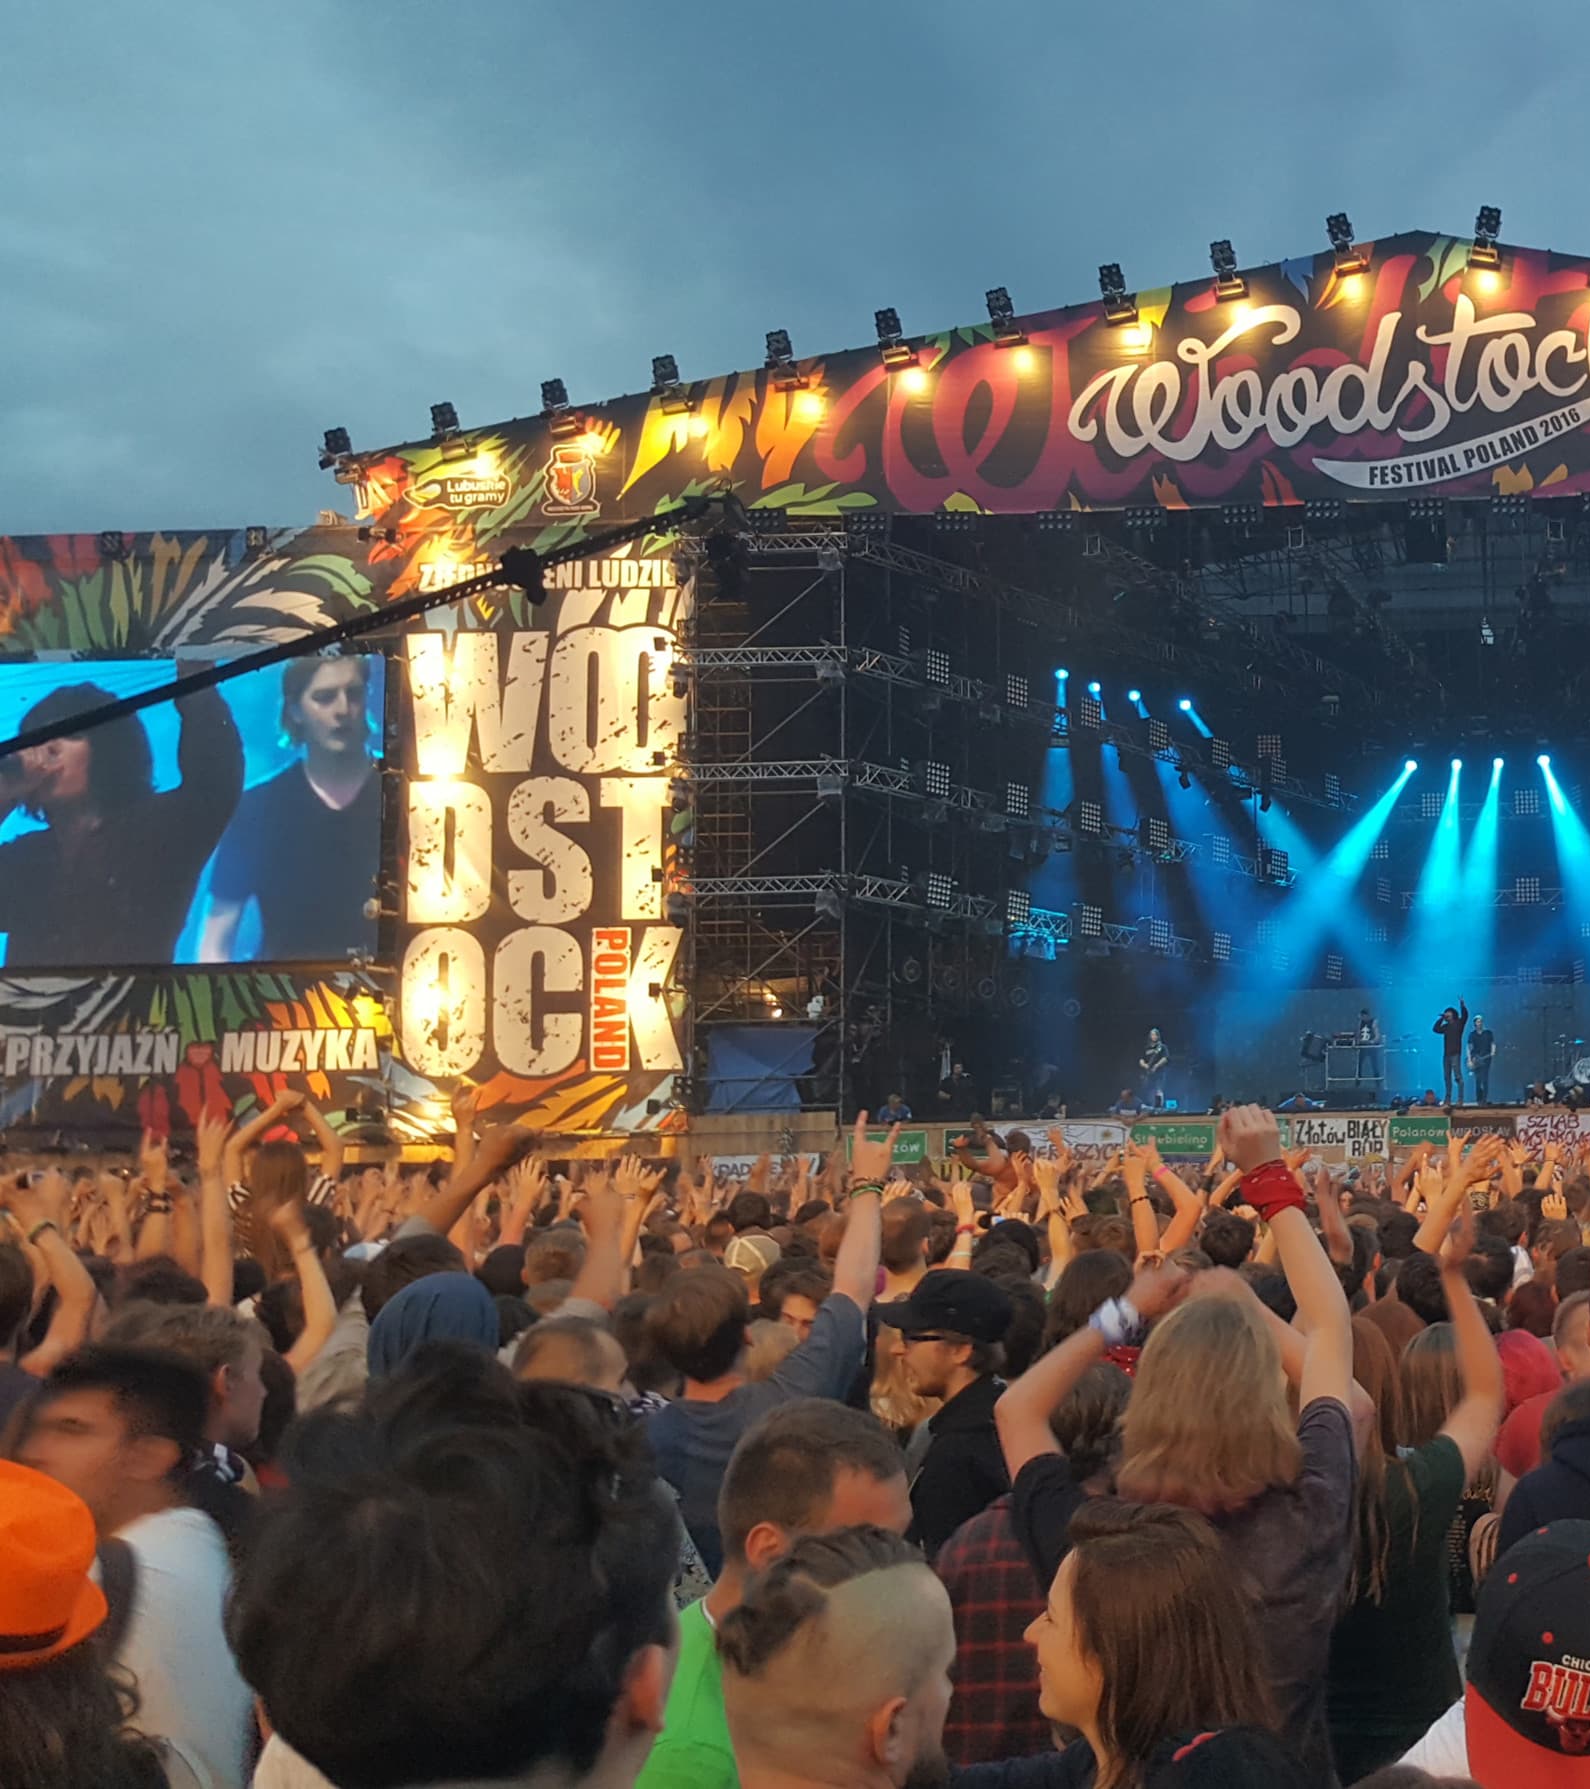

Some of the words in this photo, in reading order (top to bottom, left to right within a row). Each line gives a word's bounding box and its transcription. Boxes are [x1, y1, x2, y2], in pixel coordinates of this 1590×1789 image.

[1368, 455, 1461, 486] FESTIVAL
[1464, 426, 1540, 472] POLAND
[1539, 406, 1582, 444] 2016
[447, 478, 506, 492] Lubuskie
[449, 493, 464, 503] tu
[464, 492, 504, 506] gramy
[587, 559, 677, 589] LUDZIE
[405, 777, 672, 925] DST
[592, 928, 629, 1070] POLAND
[5, 1027, 178, 1076] PRZYJAŹŃ
[221, 1028, 379, 1073] MUZYKA
[1347, 1119, 1388, 1139] BIAŁY
[1392, 1125, 1445, 1138] Polanów
[1526, 1114, 1580, 1129] SZTAB
